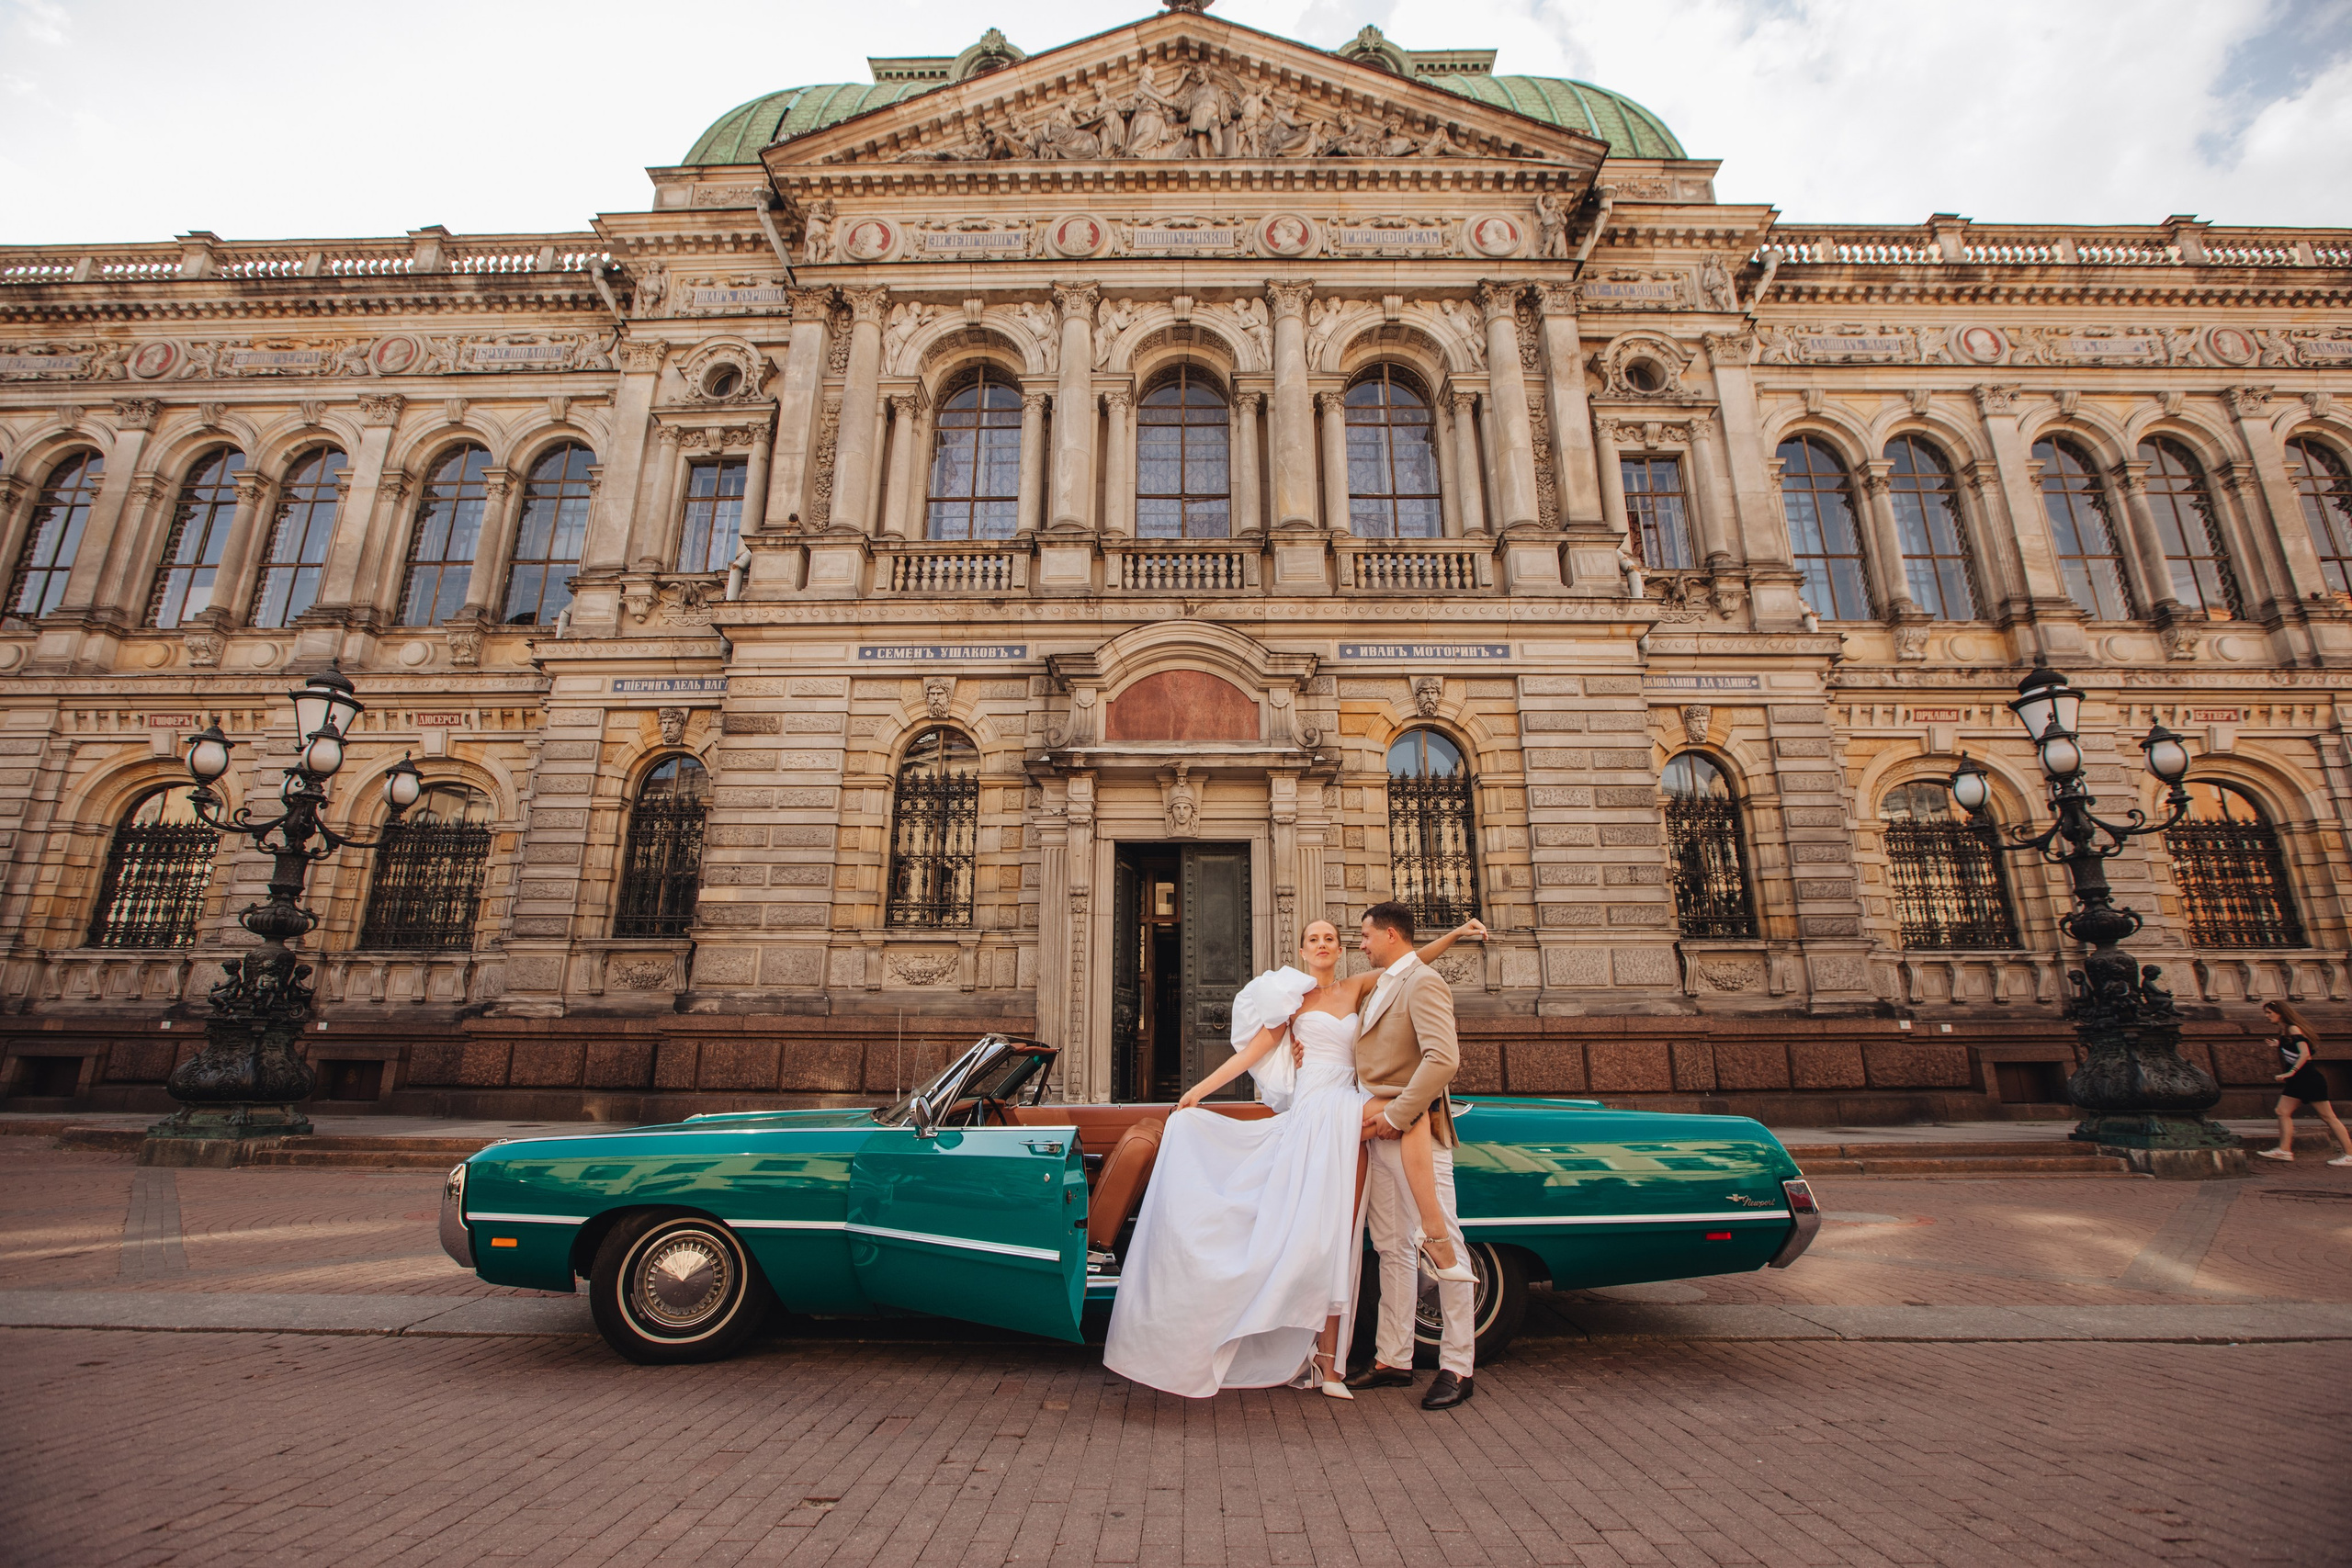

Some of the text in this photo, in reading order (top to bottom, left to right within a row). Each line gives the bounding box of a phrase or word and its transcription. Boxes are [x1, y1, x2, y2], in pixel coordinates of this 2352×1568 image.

[876, 647, 1008, 659] СЕМЕНЪ УШАКОВЪ
[1359, 646, 1490, 657] ИВАНЪ МОТОРИНЪ
[673, 680, 701, 691] ДЕЛЬ
[1700, 677, 1715, 688] ДА
[1717, 678, 1751, 688] УДИНЕ
[418, 715, 459, 726] ДЮСЕРСО
[1742, 1195, 1776, 1208] Newport
